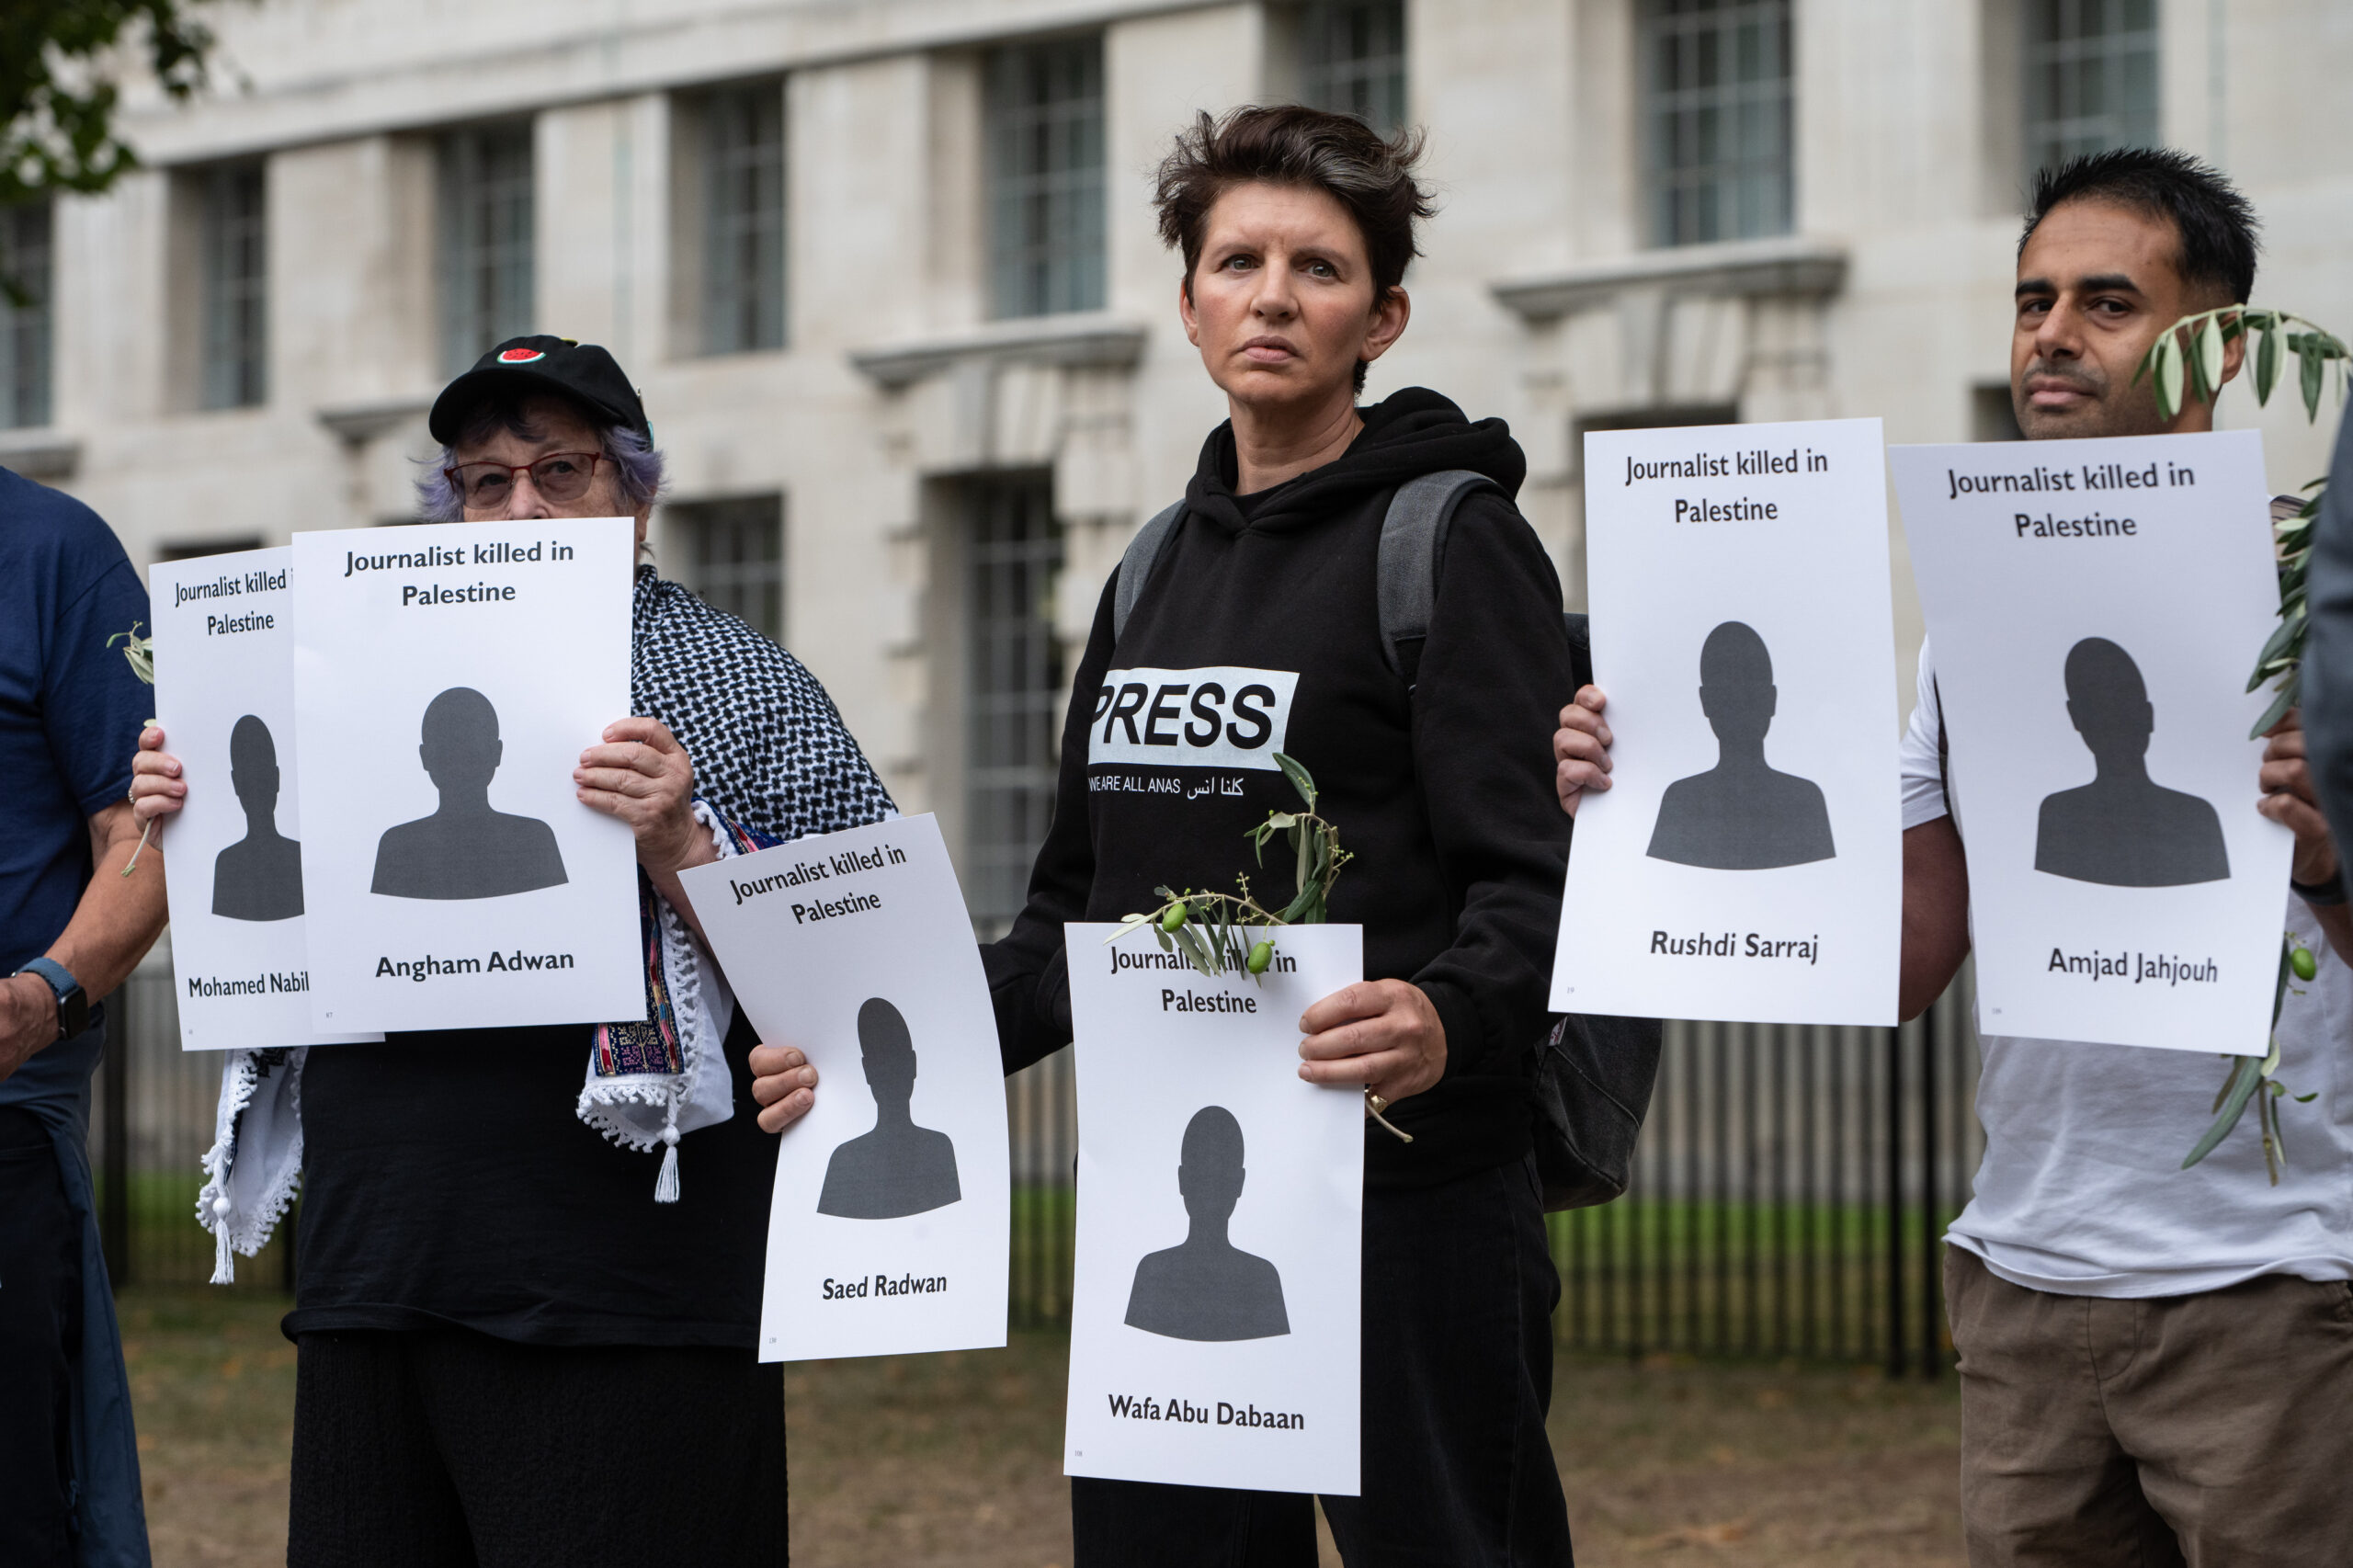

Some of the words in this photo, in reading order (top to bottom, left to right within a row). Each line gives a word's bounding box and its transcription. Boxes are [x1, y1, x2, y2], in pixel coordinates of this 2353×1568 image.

[1625, 452, 1730, 487] Journalist
[1736, 449, 1799, 475] killed
[1806, 448, 1828, 472] in
[1948, 466, 2076, 500] Journalist
[2082, 462, 2159, 491] killed
[2167, 461, 2195, 487] in
[1675, 496, 1778, 523] Palestine
[2014, 511, 2137, 538] Palestine
[344, 545, 466, 578] Journalist
[473, 539, 542, 564] killed
[551, 540, 574, 562] in
[175, 575, 242, 608] Journalist
[244, 567, 288, 594] killed
[403, 581, 516, 607] Palestine
[207, 608, 275, 636] Palestine
[1092, 682, 1277, 750] PRESS
[1122, 776, 1145, 792] ALL
[1147, 778, 1181, 794] ANAS
[1220, 777, 1245, 797] كلنا
[729, 859, 831, 905] Journalist
[829, 846, 885, 877] killed
[884, 844, 908, 865] in
[790, 892, 881, 925] Palestine
[1275, 949, 1298, 973] in
[1650, 930, 1736, 957] Rushdi
[1745, 932, 1819, 966] Sarraj
[375, 954, 481, 983] Angham
[486, 949, 574, 972] Adwan
[2048, 948, 2128, 982] Amjad
[2134, 952, 2218, 986] Jahjouh
[188, 973, 266, 998] Mohamed
[269, 971, 310, 994] Nabil
[1161, 988, 1257, 1014] Palestine
[822, 1276, 869, 1301] Saed
[874, 1272, 948, 1297] Radwan
[1108, 1393, 1162, 1421] Wafa
[1165, 1398, 1209, 1425] Abu
[1216, 1402, 1304, 1430] Dabaan
